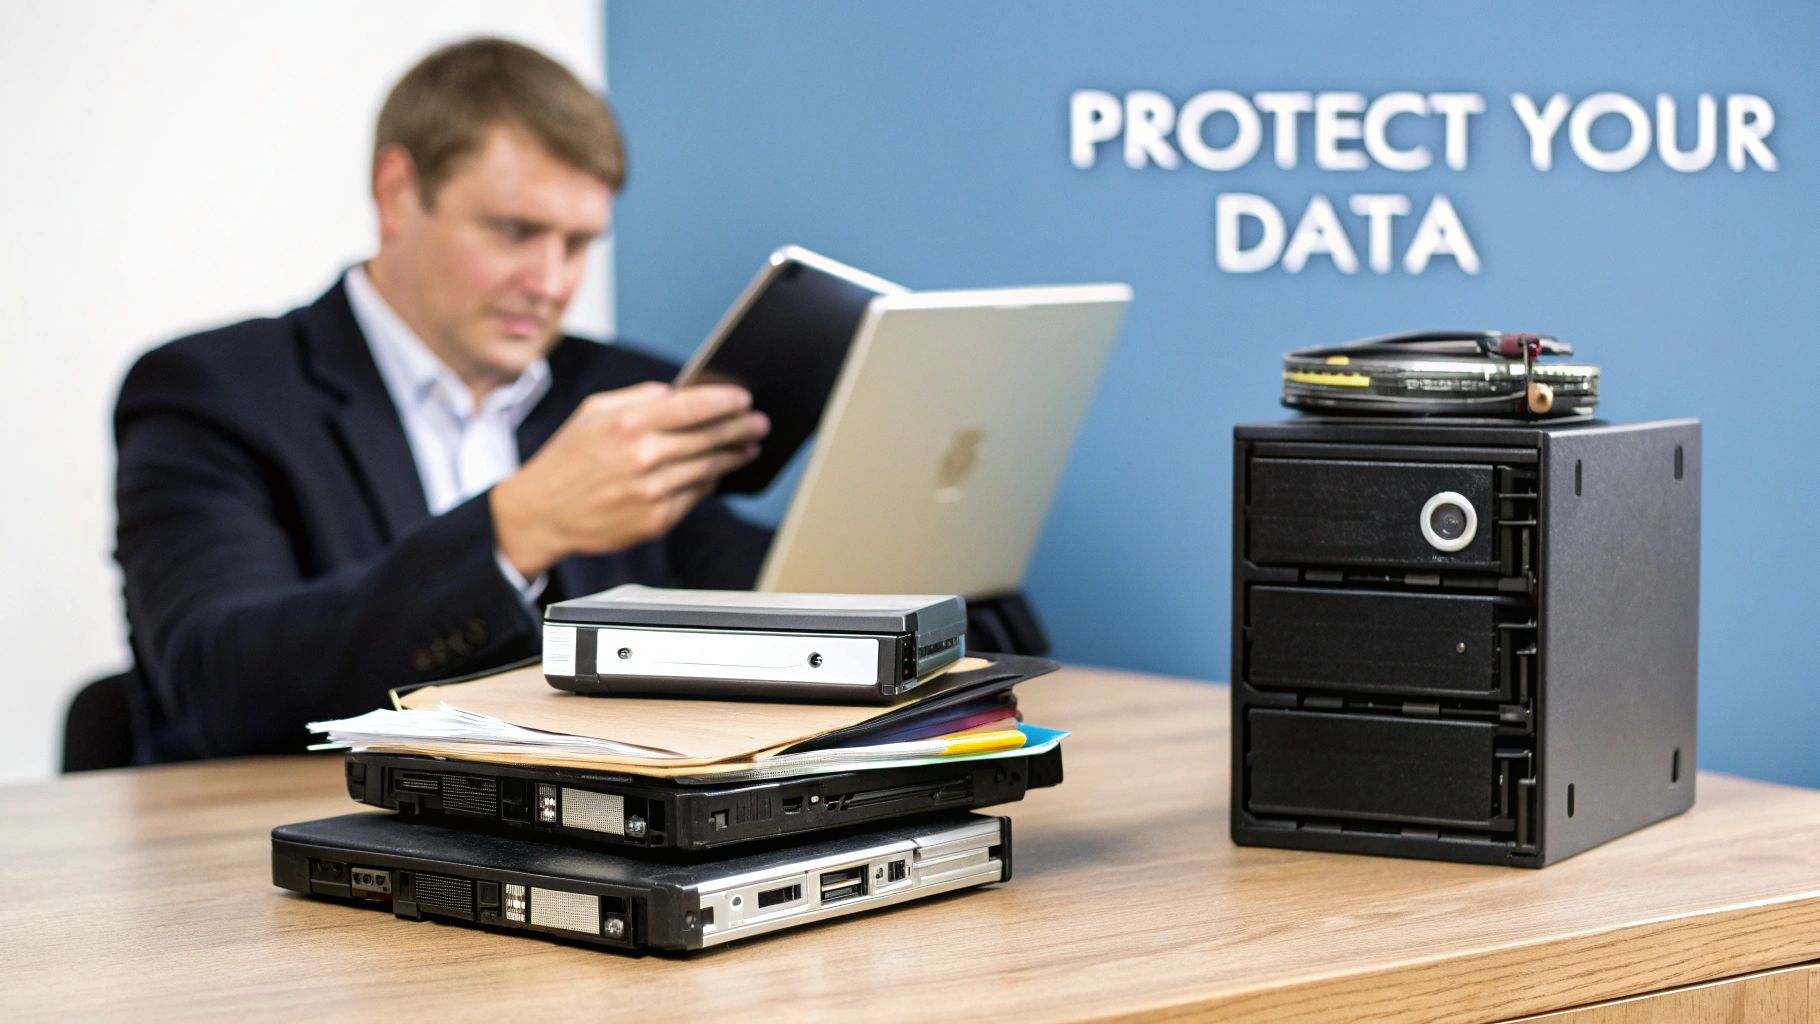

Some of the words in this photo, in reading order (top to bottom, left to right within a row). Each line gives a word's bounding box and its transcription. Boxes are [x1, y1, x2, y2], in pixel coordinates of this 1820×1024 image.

[1070, 90, 1486, 170] PROTECT
[1511, 92, 1778, 172] YOUR
[1216, 193, 1481, 274] DATA
